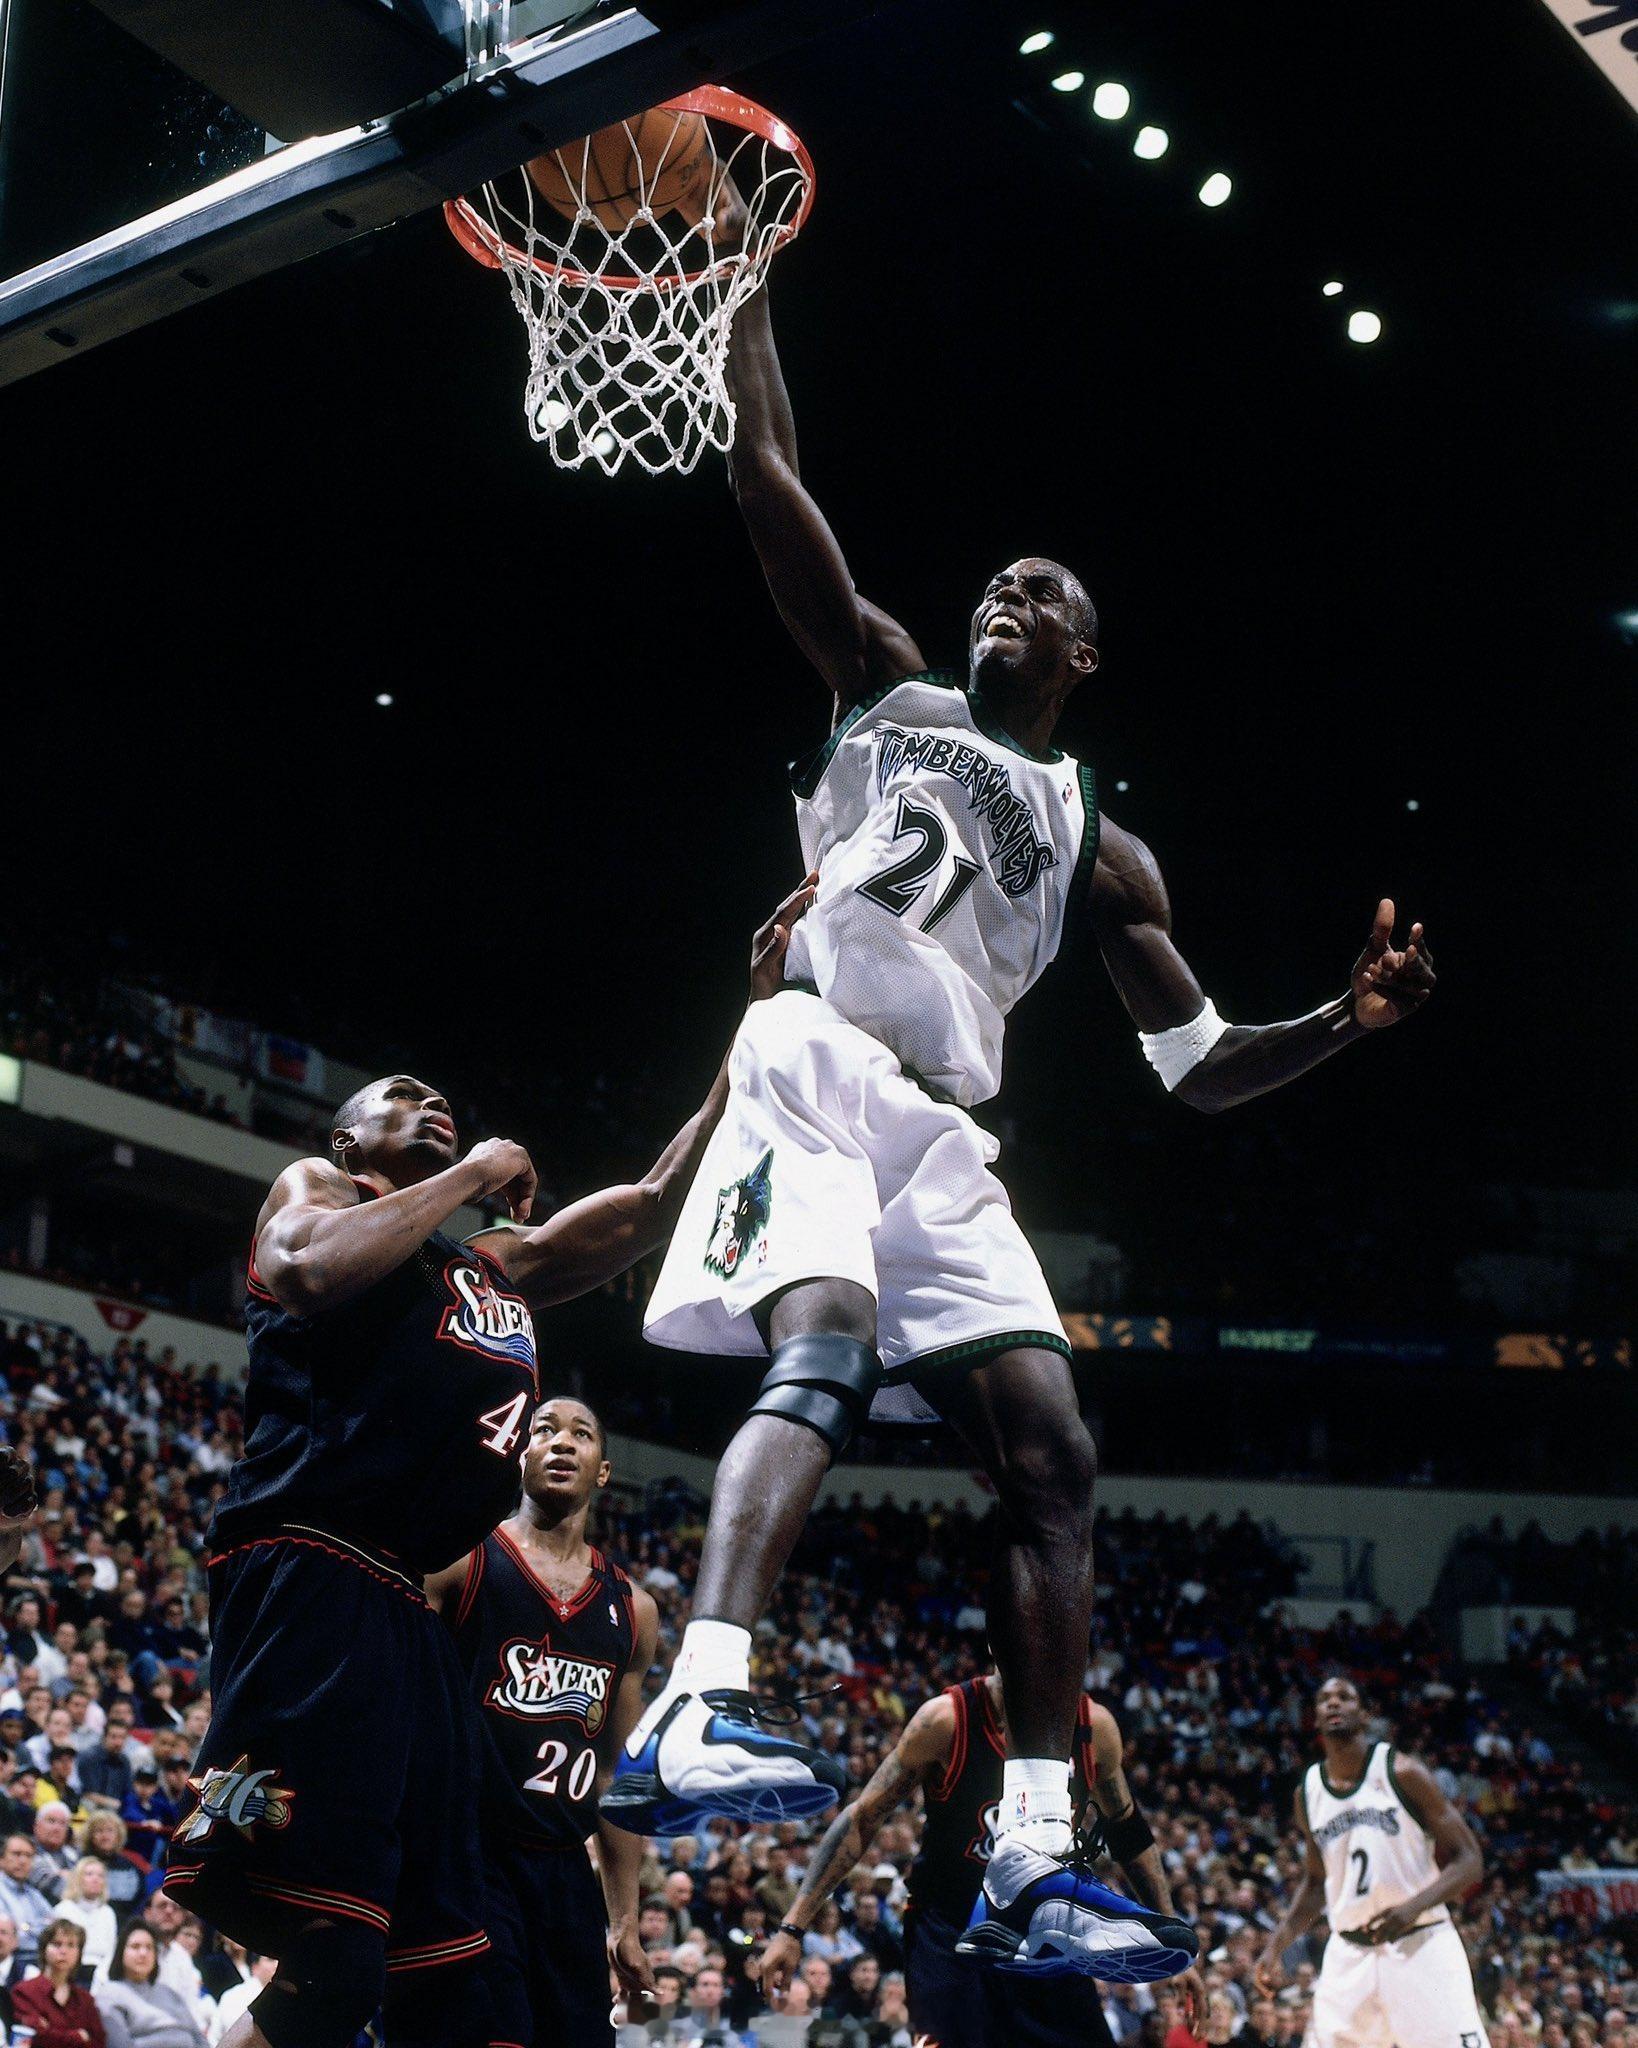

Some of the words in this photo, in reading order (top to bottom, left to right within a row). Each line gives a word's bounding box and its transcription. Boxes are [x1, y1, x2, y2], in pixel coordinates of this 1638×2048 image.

[873, 727, 1058, 897] TIMBERWOLVES
[855, 794, 983, 933] 21
[476, 1390, 536, 1478] 4
[492, 1644, 611, 1708] SIXERS
[523, 1740, 597, 1801] 20
[1351, 1848, 1370, 1897] 2
